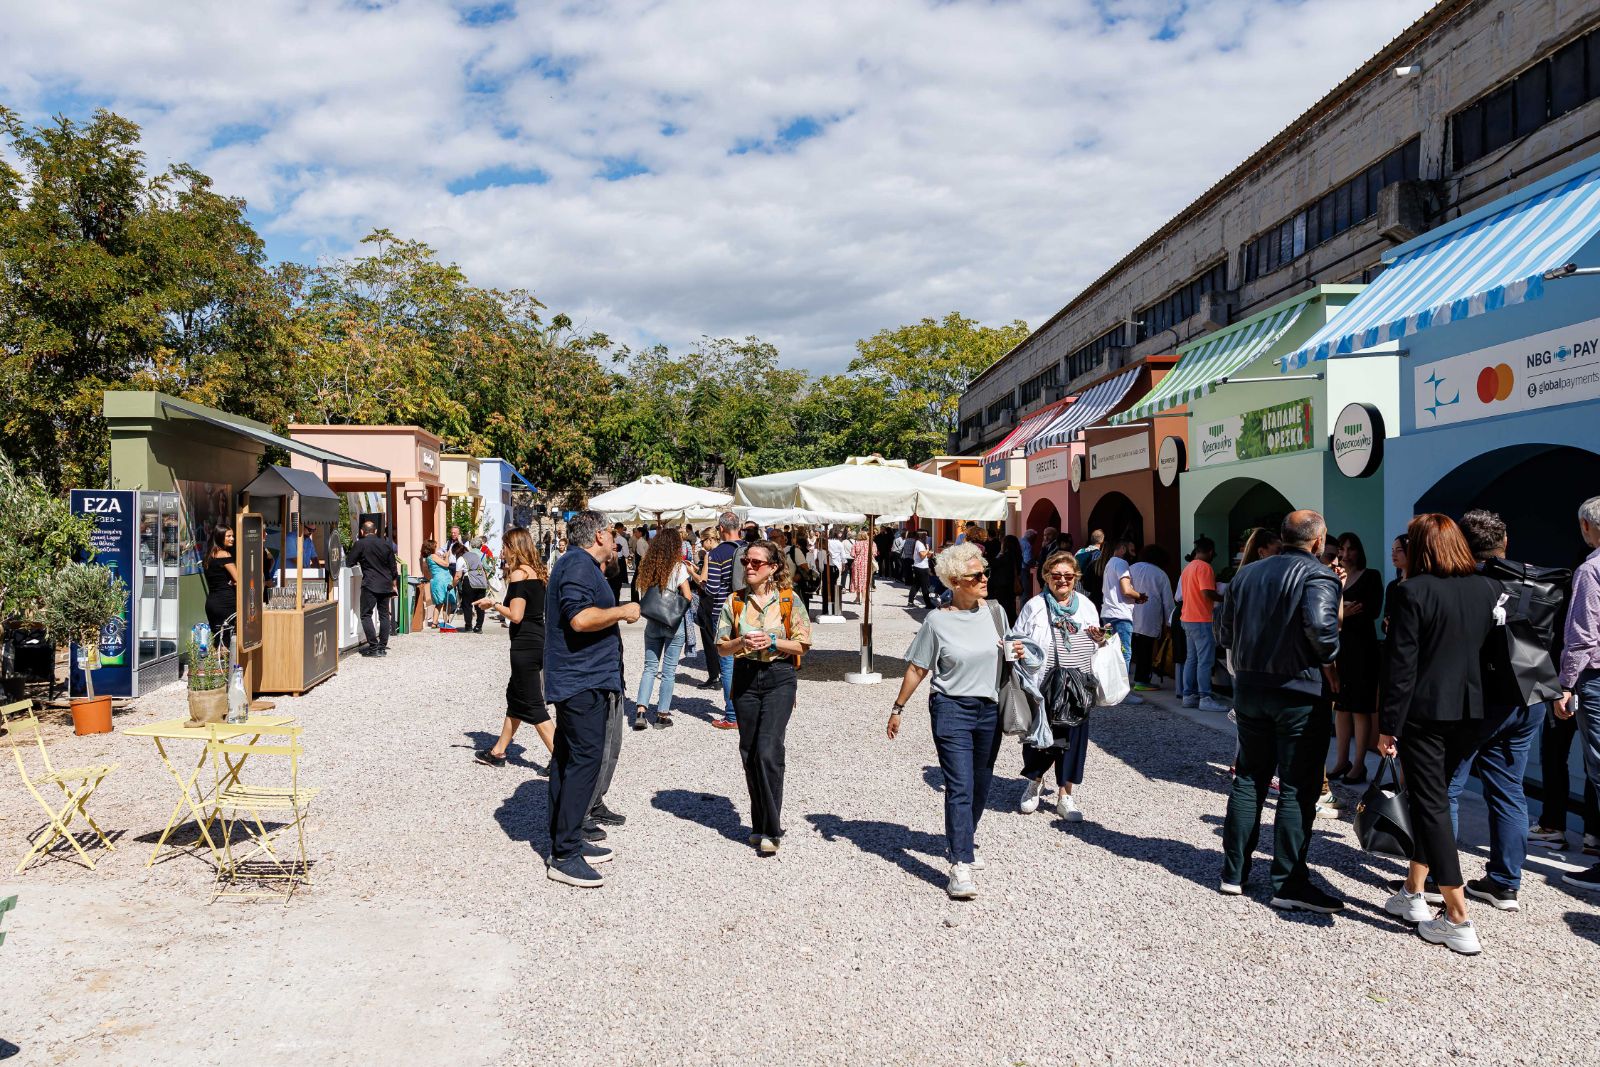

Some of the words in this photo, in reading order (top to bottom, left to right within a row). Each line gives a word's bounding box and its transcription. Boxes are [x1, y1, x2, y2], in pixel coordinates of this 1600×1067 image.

[1526, 350, 1552, 369] NBG
[1573, 338, 1599, 358] PAY
[1538, 371, 1600, 395] globalpayments
[1262, 405, 1302, 431] ΑΓΑΠΑΜΕ
[1267, 428, 1304, 450] ΦΡΕΣΚΟ
[83, 498, 121, 512] EZA
[331, 548, 339, 562] EZA
[101, 635, 122, 645] EZA
[313, 629, 328, 657] EZA
